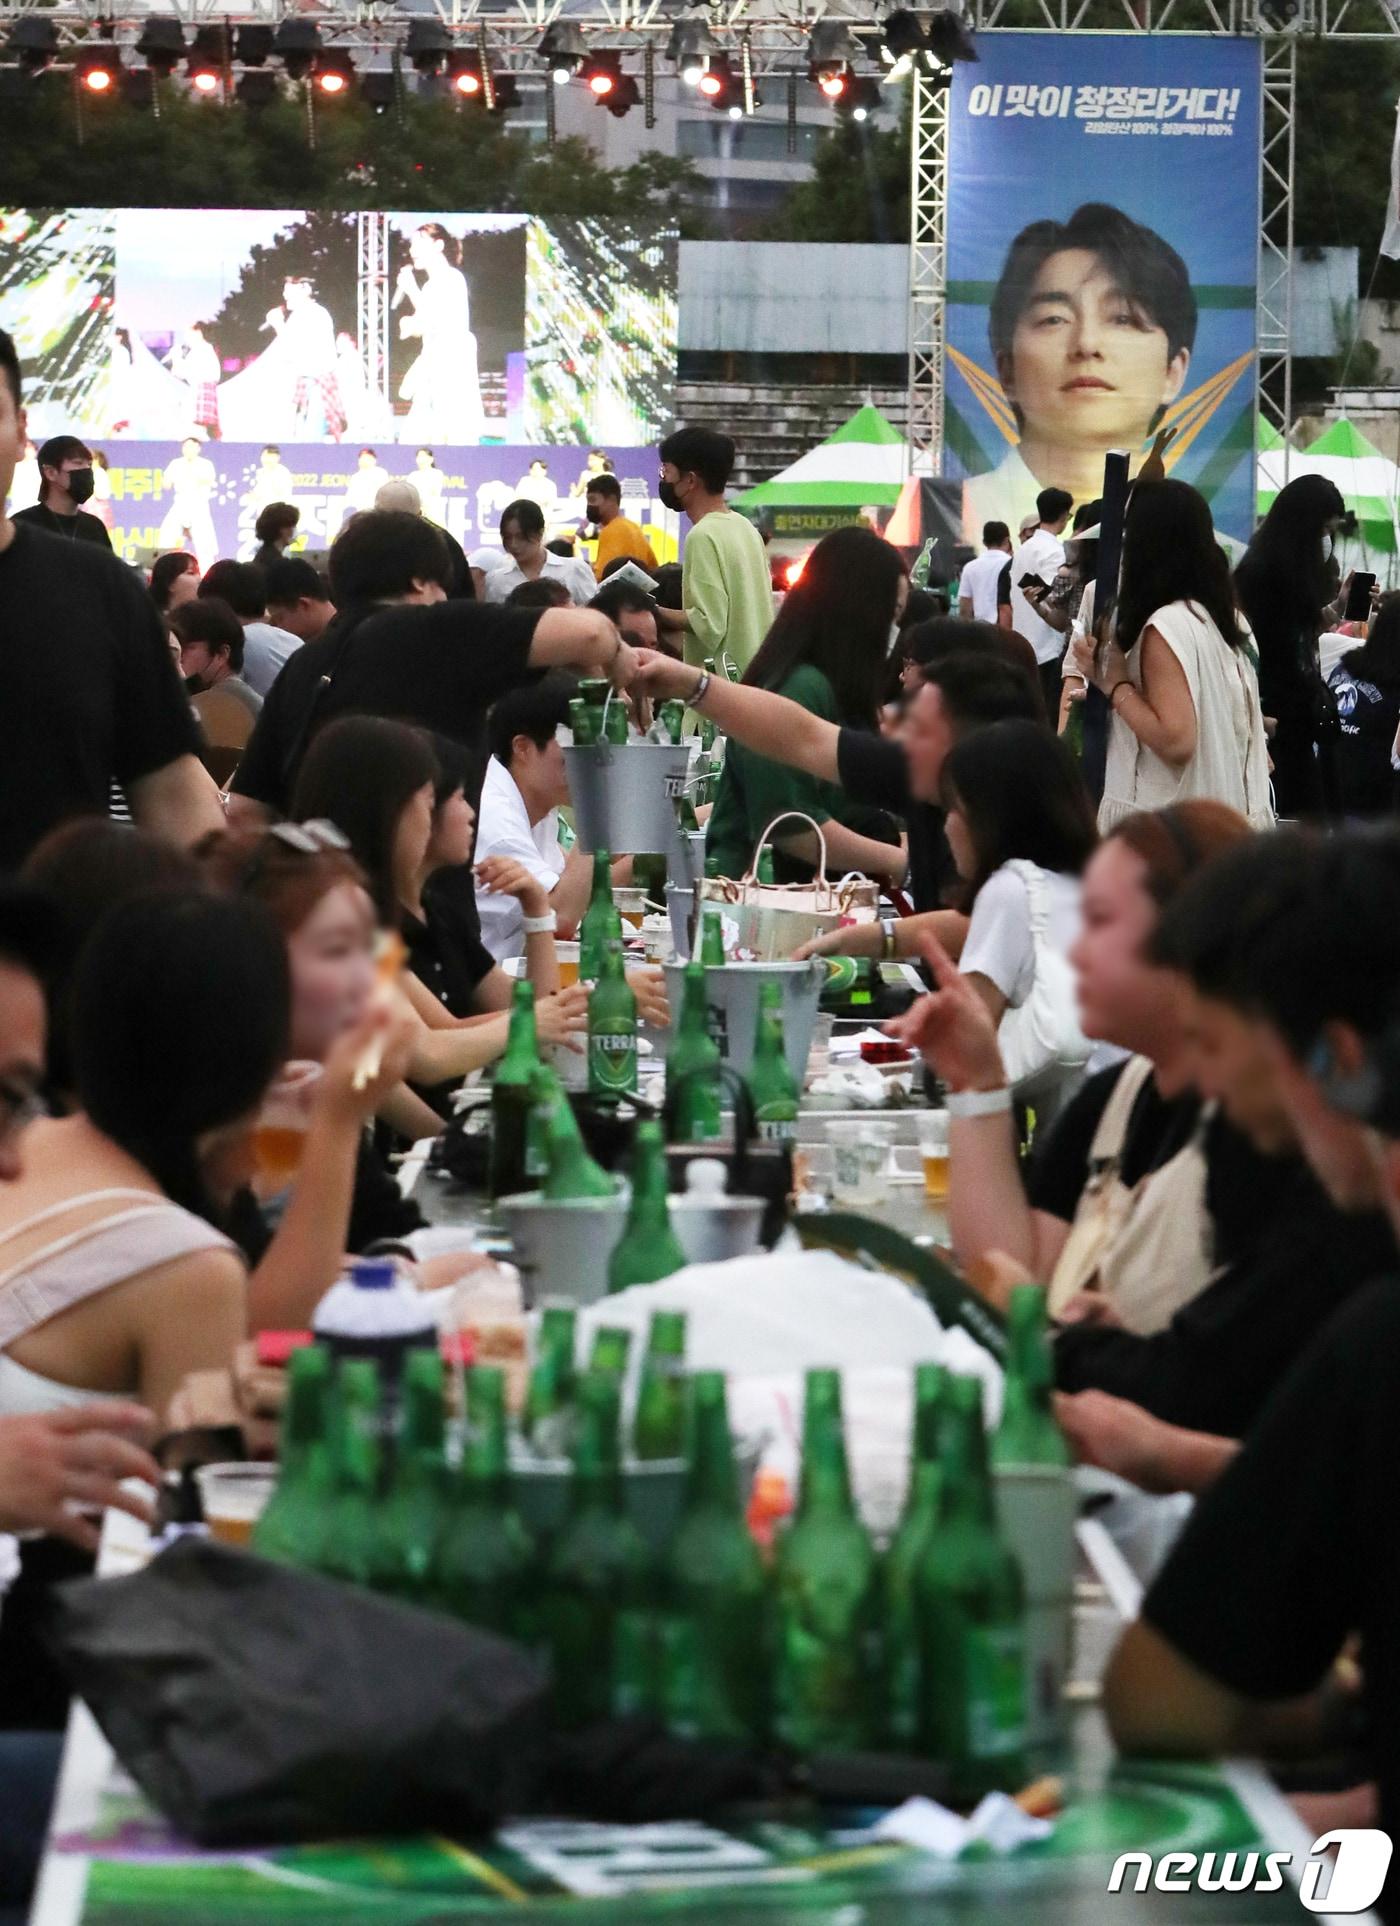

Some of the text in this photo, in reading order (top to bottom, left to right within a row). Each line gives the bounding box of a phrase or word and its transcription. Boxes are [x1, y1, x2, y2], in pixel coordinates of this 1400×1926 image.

[1074, 86, 1241, 121] 청정라거다!
[1131, 122, 1158, 135] 100%
[1207, 123, 1233, 136] 100%
[591, 1034, 637, 1051] TERRA
